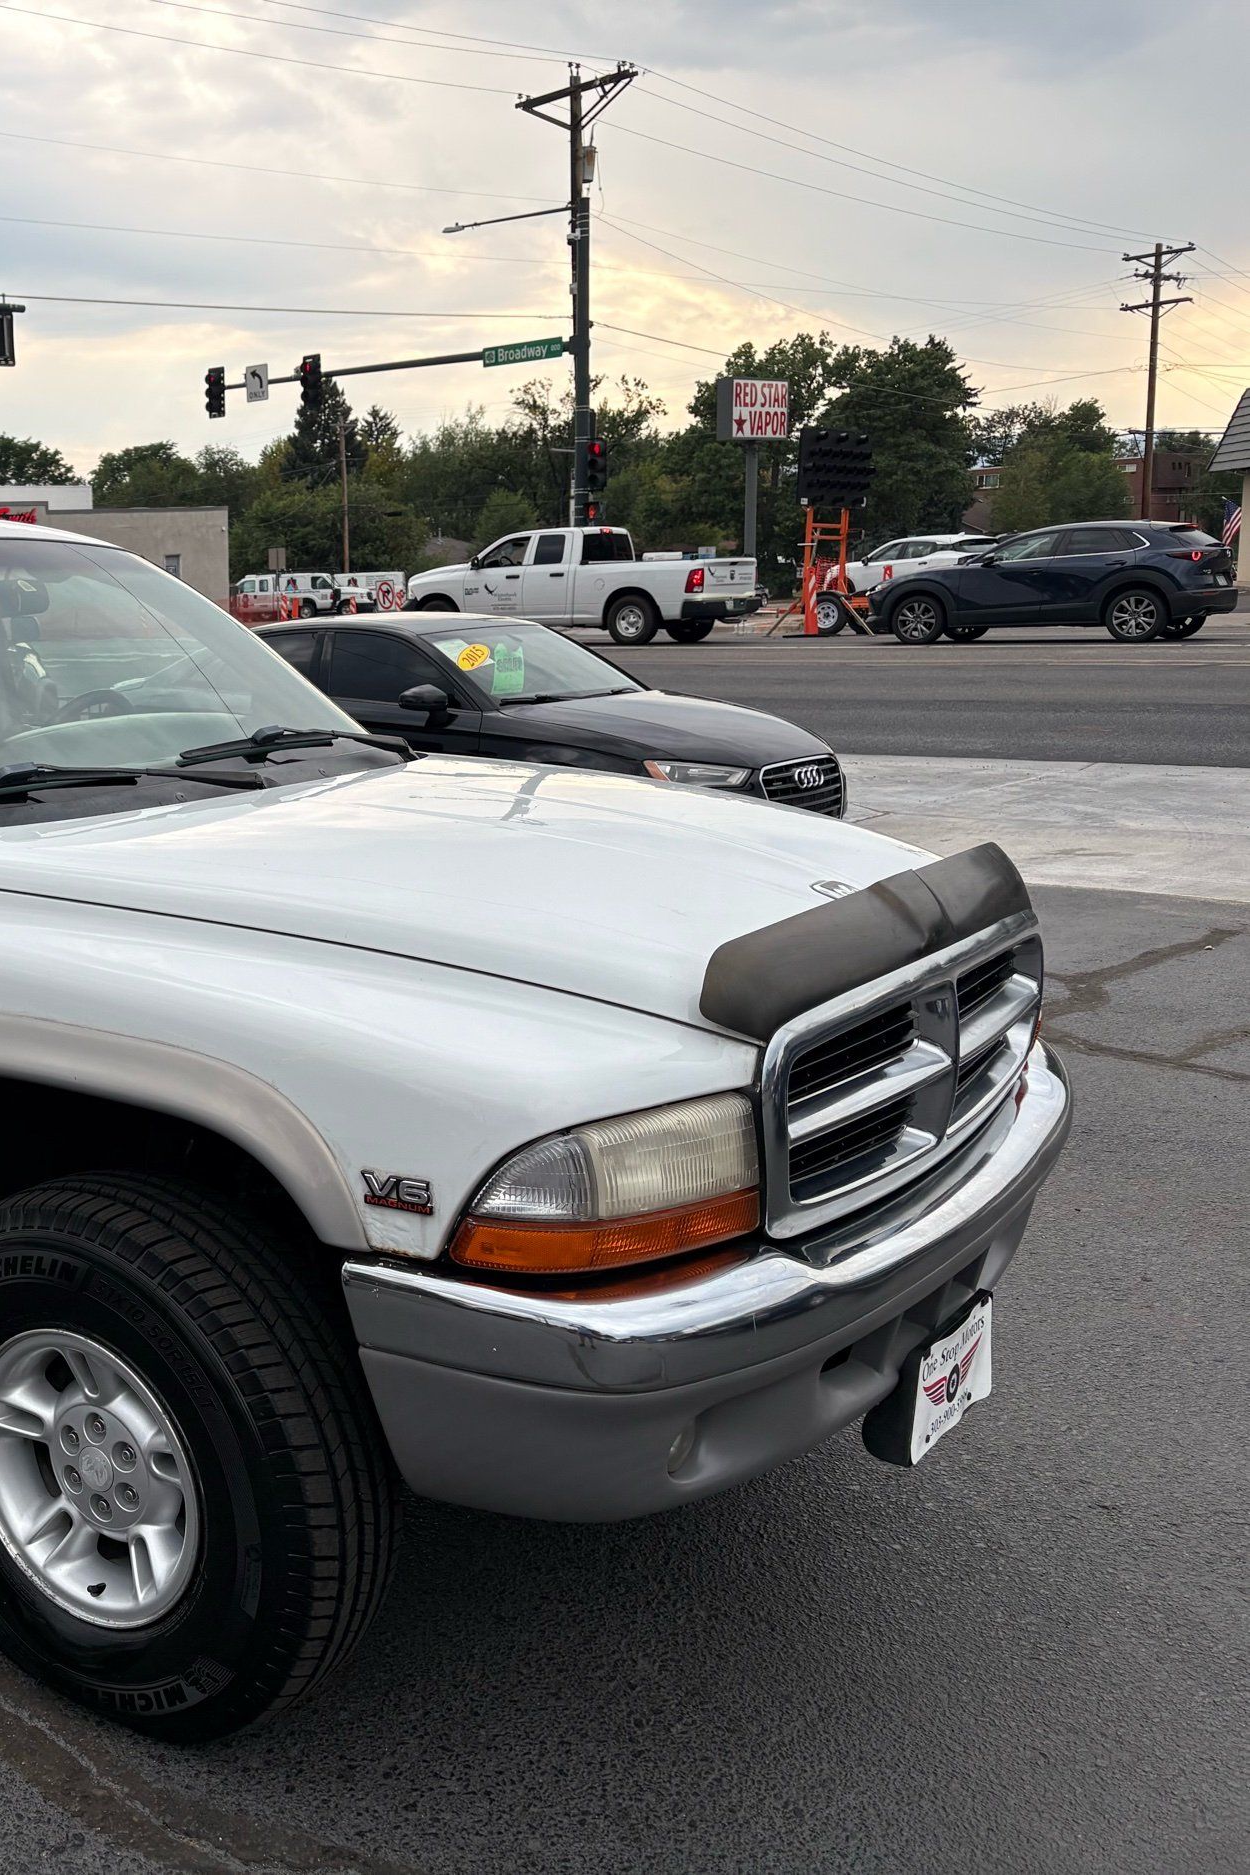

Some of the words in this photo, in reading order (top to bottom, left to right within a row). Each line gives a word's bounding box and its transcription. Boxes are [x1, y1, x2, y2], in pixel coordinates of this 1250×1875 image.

[498, 344, 548, 362] Broadway
[249, 390, 265, 399] ONLY
[735, 382, 758, 407] RED
[760, 383, 787, 408] STAR
[749, 411, 786, 436] VAPOR
[462, 645, 485, 667] 2015
[361, 1169, 432, 1205] V6
[366, 1196, 430, 1214] MAGNUM
[922, 1360, 937, 1382] One
[940, 1345, 959, 1369] Stop
